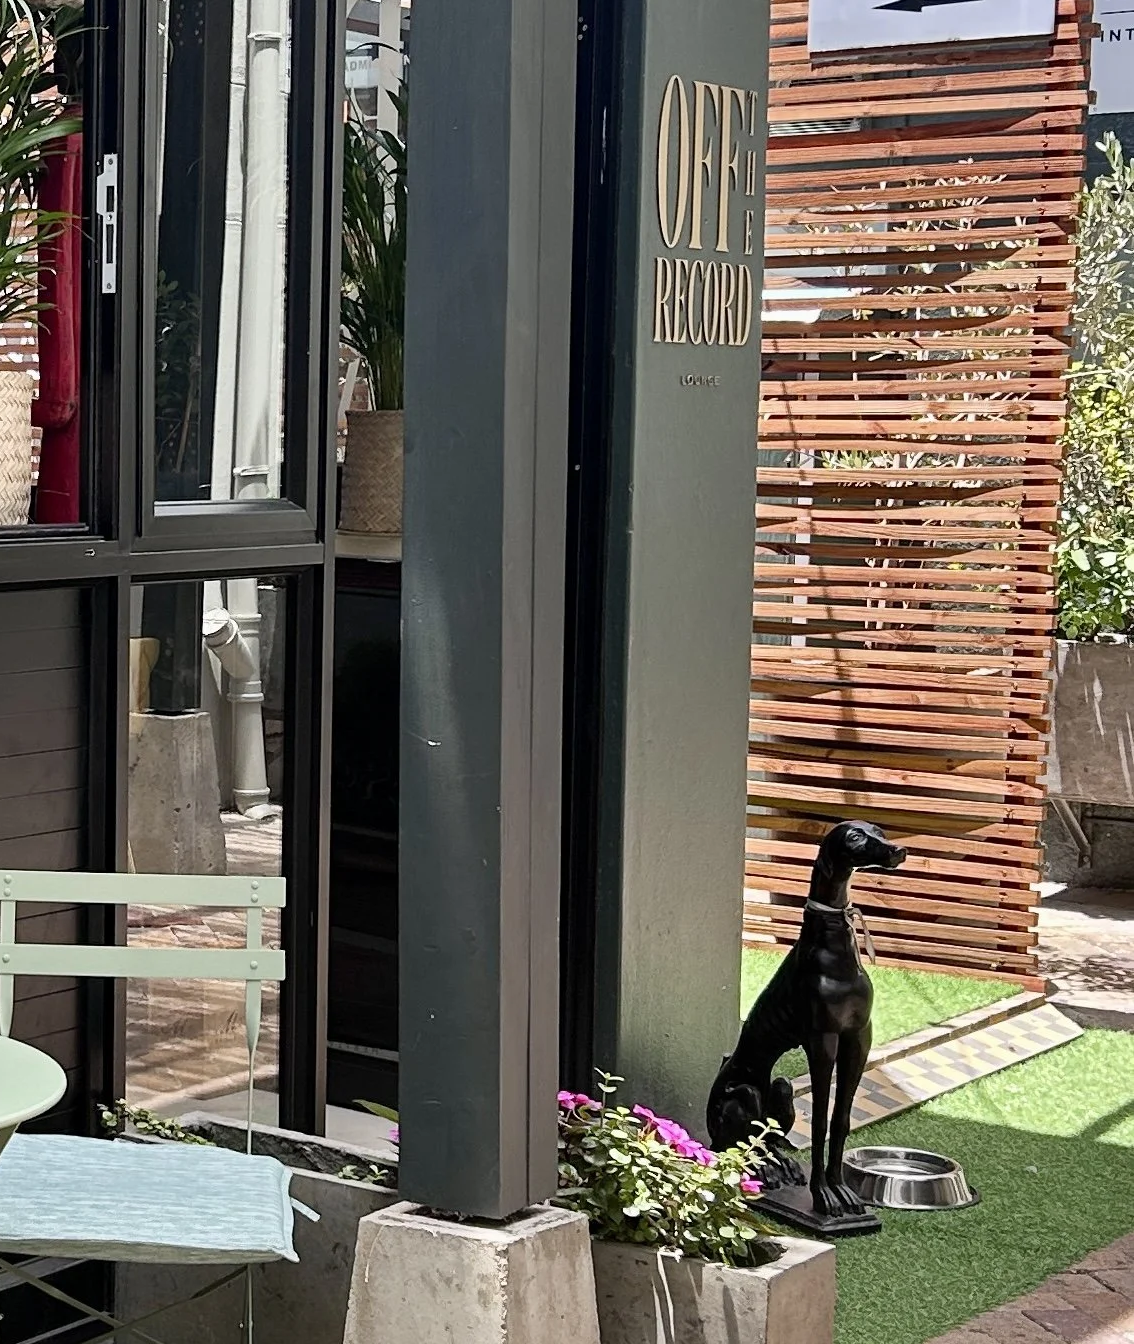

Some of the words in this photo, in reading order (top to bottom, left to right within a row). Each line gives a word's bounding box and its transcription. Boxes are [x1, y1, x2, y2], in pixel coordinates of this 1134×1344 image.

[658, 74, 745, 252] OFF
[744, 89, 758, 256] THE
[654, 256, 752, 346] RECORD
